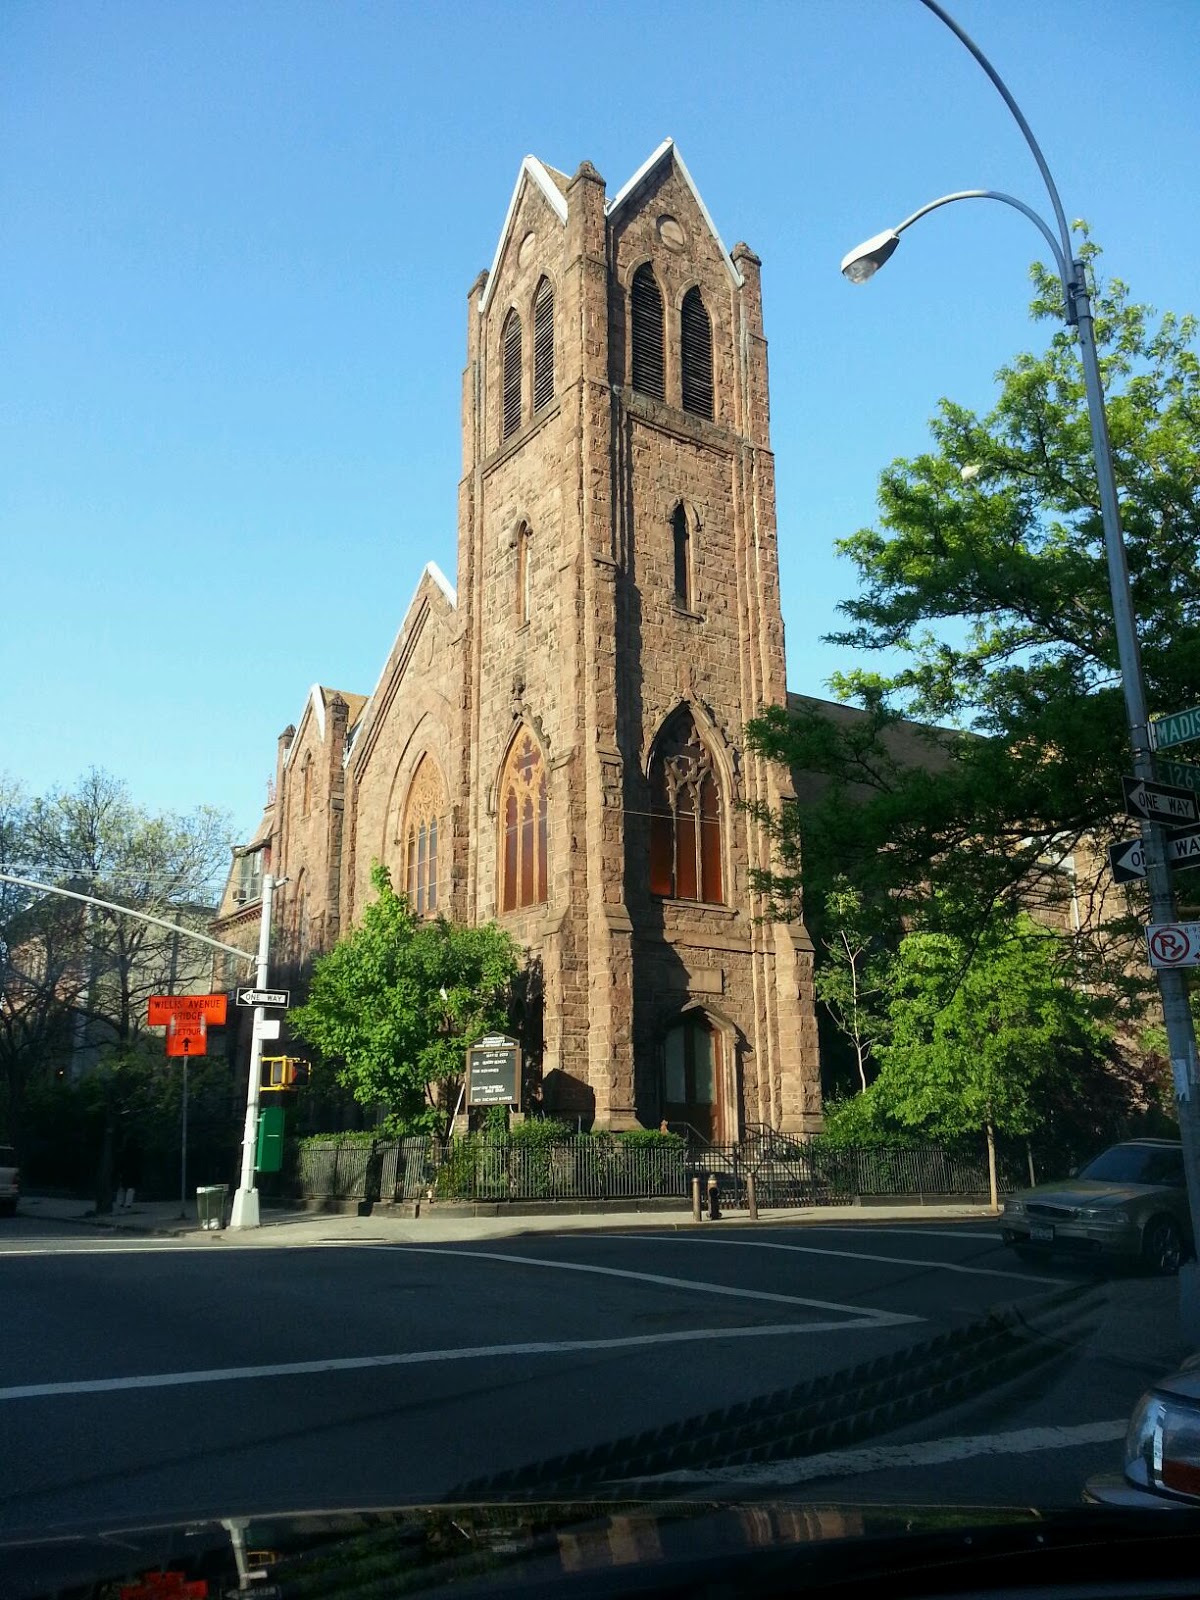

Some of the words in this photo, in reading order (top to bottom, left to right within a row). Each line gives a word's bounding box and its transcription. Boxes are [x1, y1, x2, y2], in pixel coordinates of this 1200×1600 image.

[1168, 764, 1194, 789] 126
[1138, 792, 1160, 810] ONE
[1167, 797, 1190, 816] WAY
[154, 1000, 181, 1010] WILLIS
[188, 999, 221, 1009] AVENUE
[245, 993, 261, 1001] ONE
[267, 994, 283, 1002] WAY
